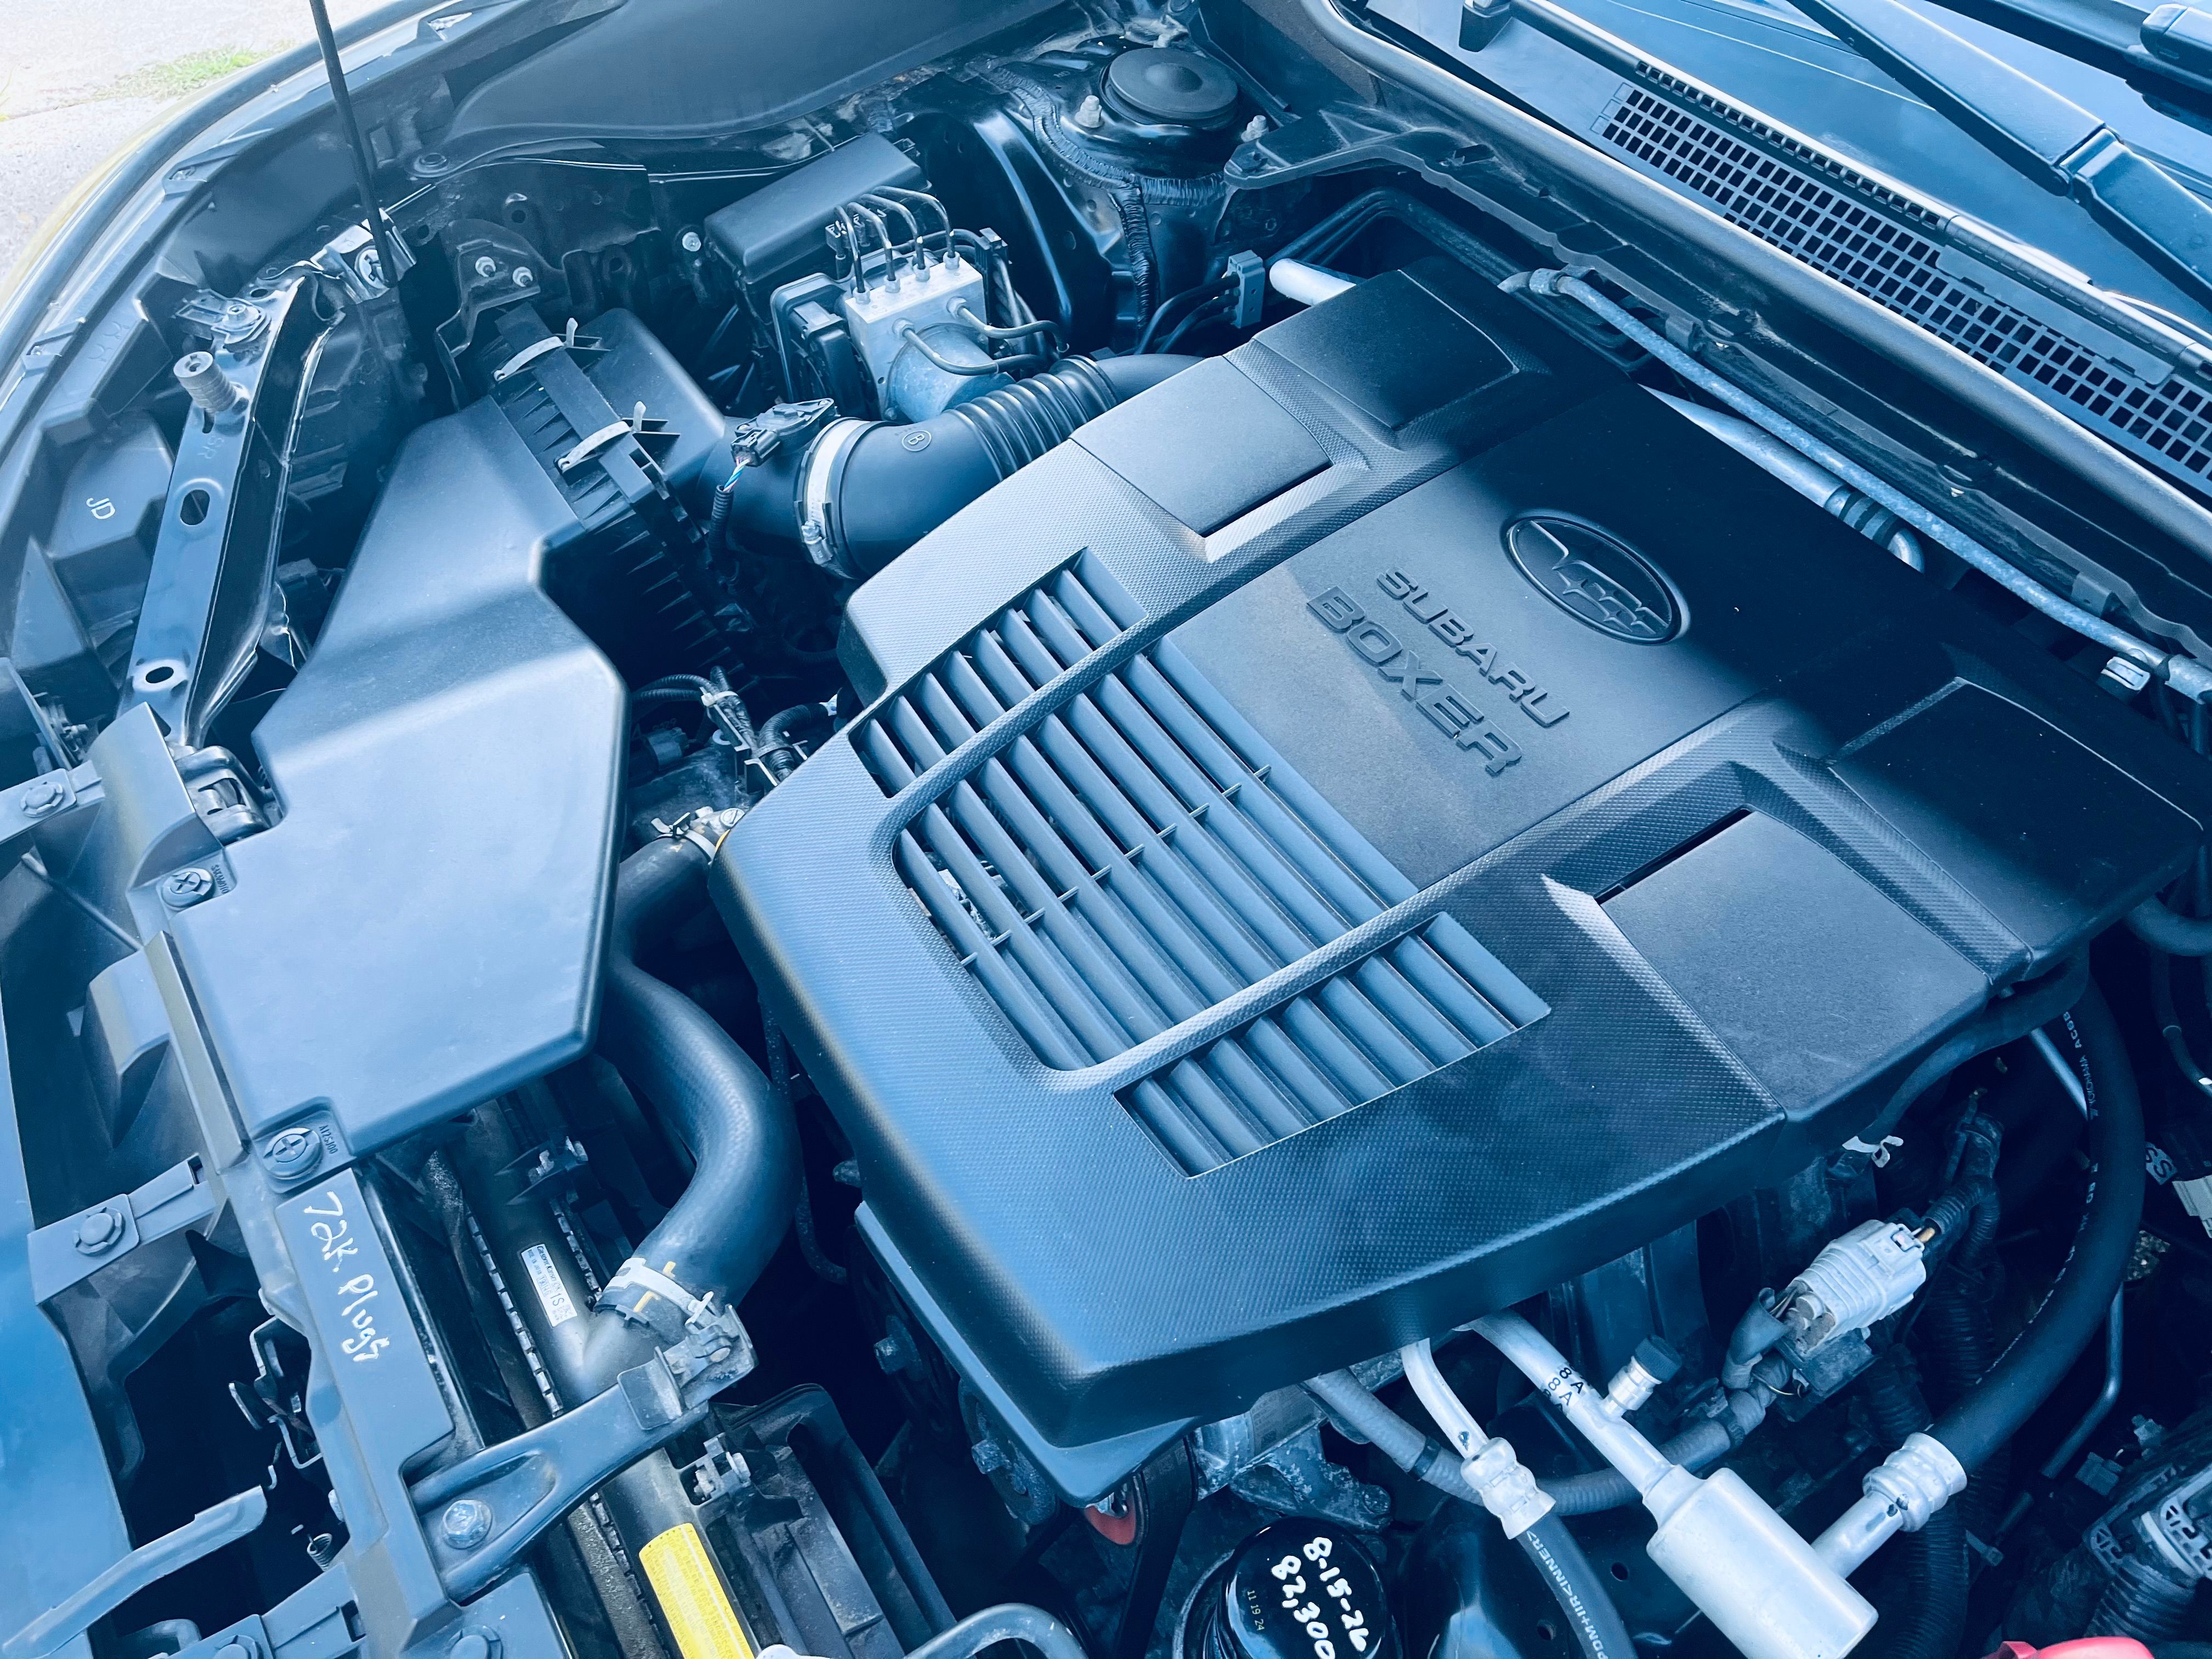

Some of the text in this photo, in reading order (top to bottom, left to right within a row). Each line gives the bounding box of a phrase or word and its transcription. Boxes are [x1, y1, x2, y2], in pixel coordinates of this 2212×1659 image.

[908, 434, 925, 445] B
[86, 498, 116, 520] JD
[1307, 586, 1523, 776] BOXER
[1377, 567, 1570, 727] SUBARU
[1271, 1555, 1335, 1659] 82,300
[1303, 1537, 1369, 1652] 8-15-26
